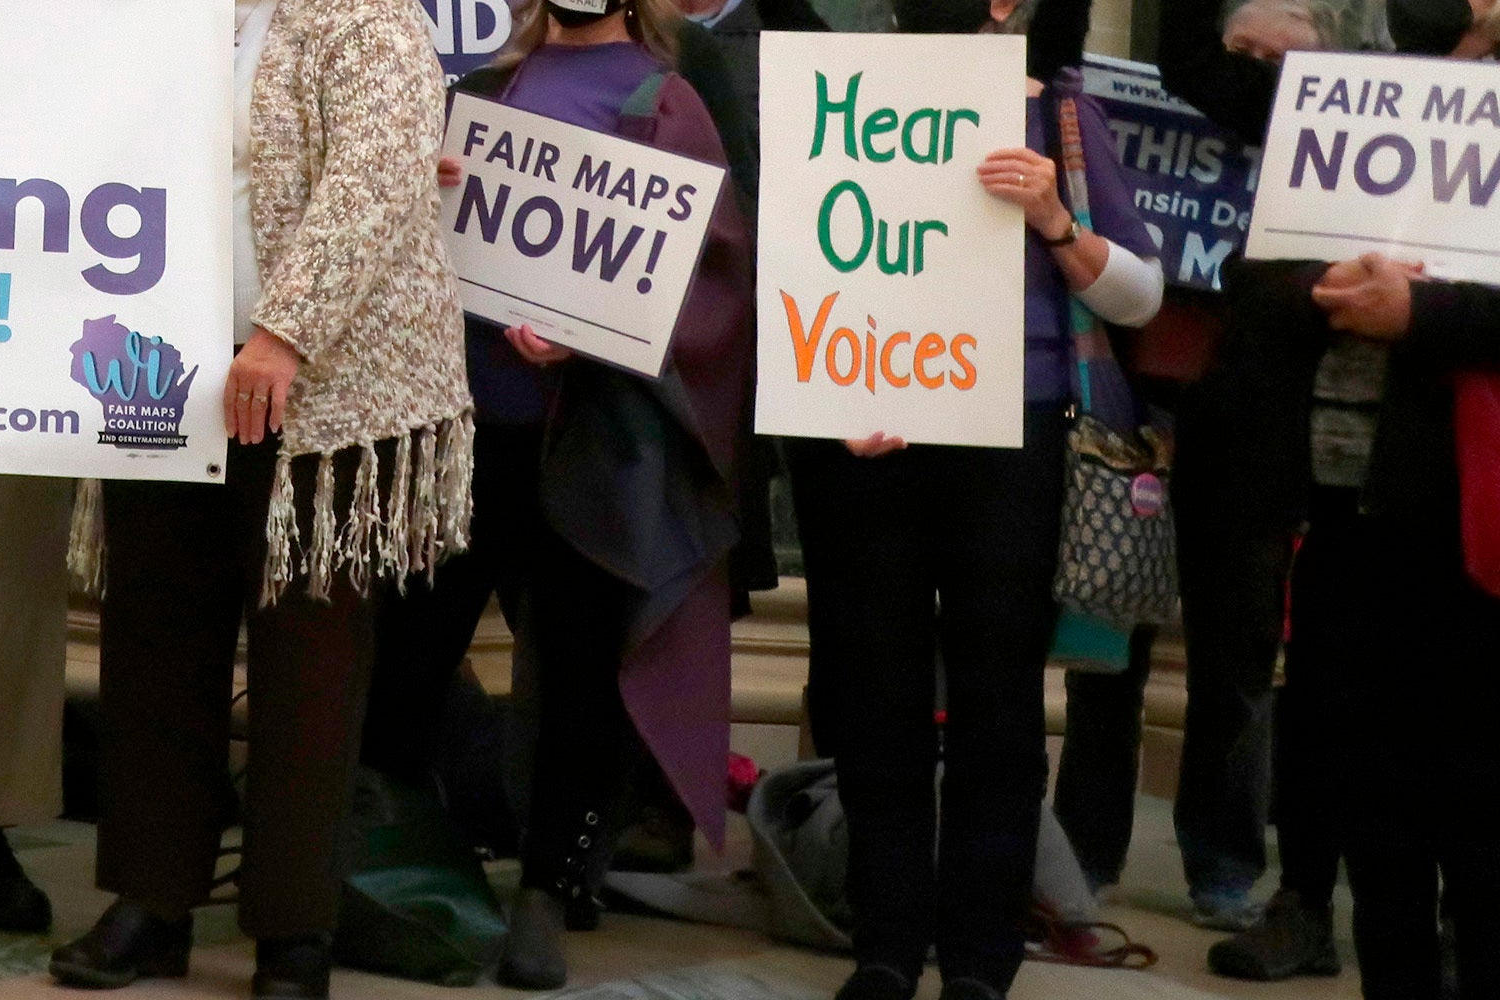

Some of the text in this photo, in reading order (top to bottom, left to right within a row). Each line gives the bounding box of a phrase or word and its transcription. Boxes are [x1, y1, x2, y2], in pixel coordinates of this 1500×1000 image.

[809, 70, 980, 165] Hear
[1295, 75, 1404, 118] FAIR
[463, 121, 697, 221] FAIR MAPS
[1108, 119, 1225, 184] THIS
[1288, 127, 1500, 208] NOW
[453, 174, 668, 295] NOW!
[817, 179, 948, 277] Our
[779, 288, 978, 396] Voices
[108, 405, 176, 418] FAIR MAPS
[108, 419, 177, 432] COALITION
[118, 435, 185, 445] GERRYMANDERING
